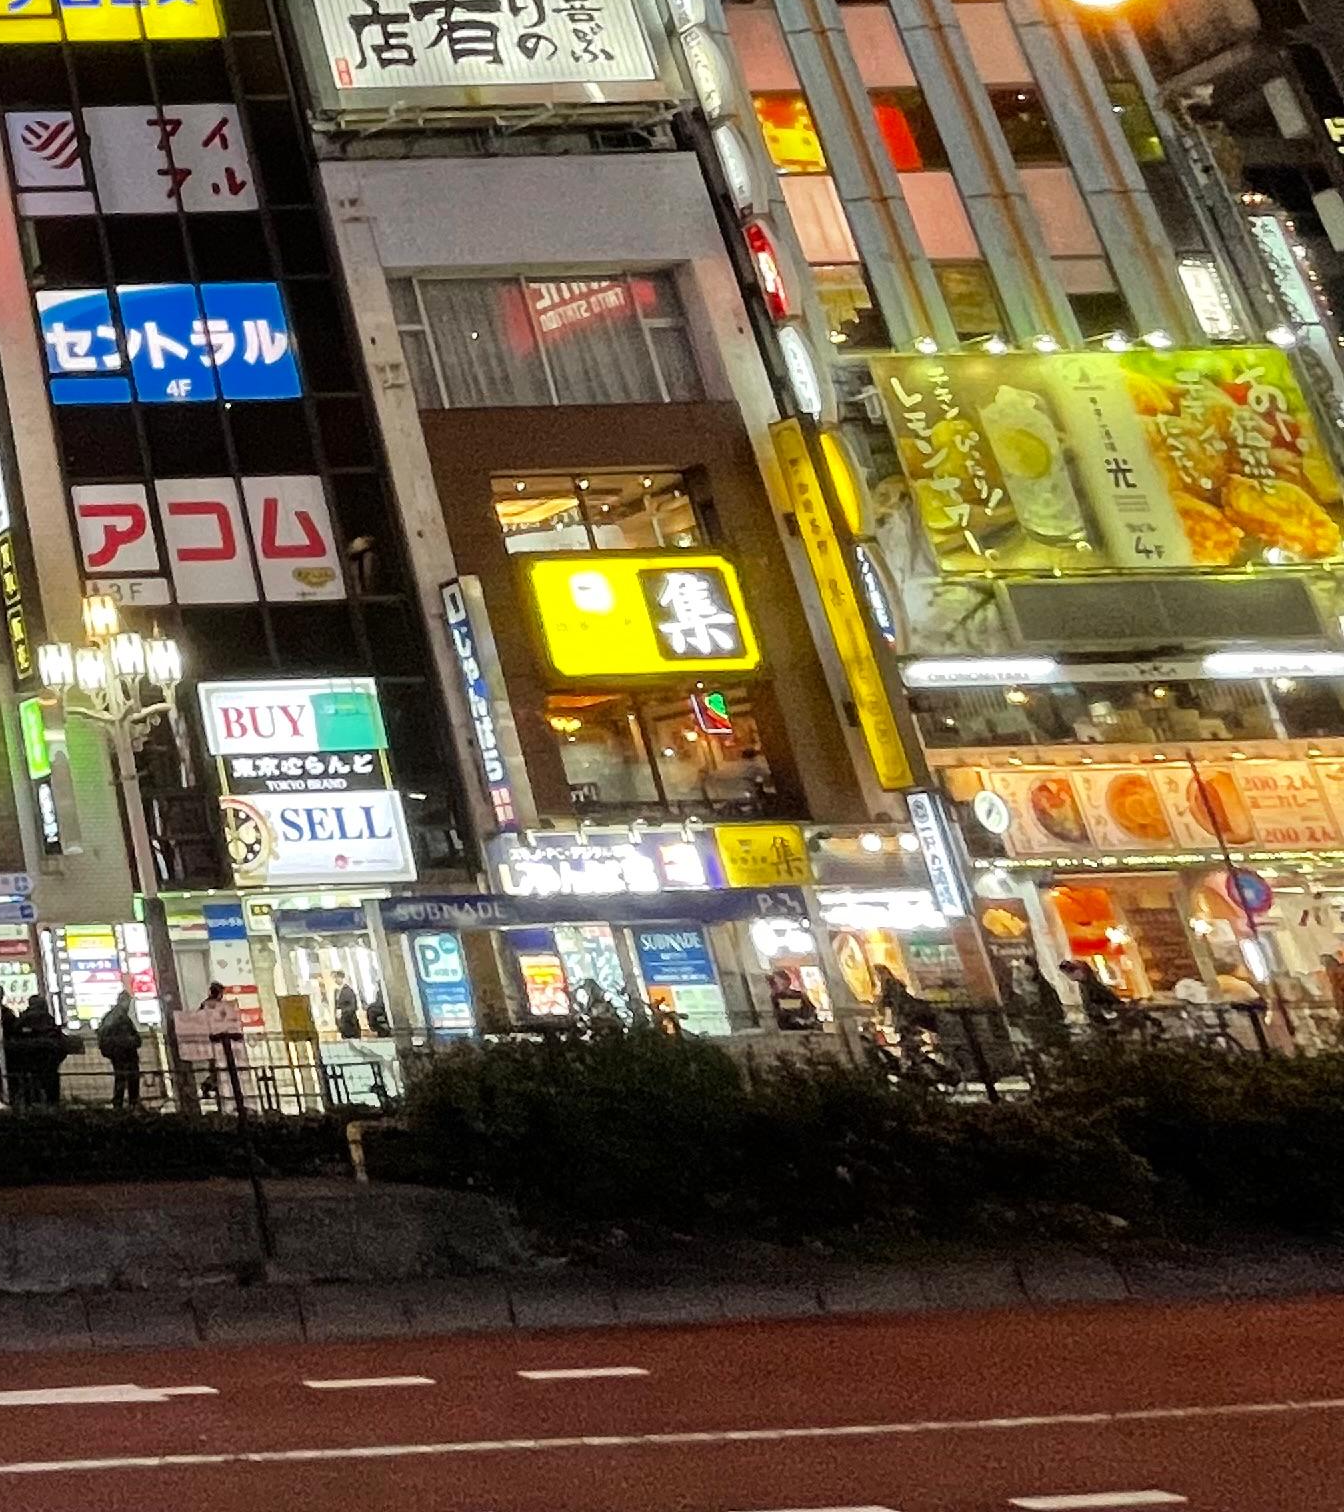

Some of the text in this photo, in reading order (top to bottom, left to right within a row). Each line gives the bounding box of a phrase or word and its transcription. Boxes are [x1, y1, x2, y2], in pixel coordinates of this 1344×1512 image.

[146, 115, 232, 152] アイ
[45, 317, 288, 370] セントラル
[165, 378, 192, 397] 4F
[78, 497, 327, 567] アコム
[108, 582, 145, 601] 3F
[658, 570, 744, 656] 集
[218, 704, 306, 739] BUY
[264, 778, 348, 792] TOKYO BRAND
[280, 805, 394, 843] SELL
[395, 899, 508, 922] SUBNADE
